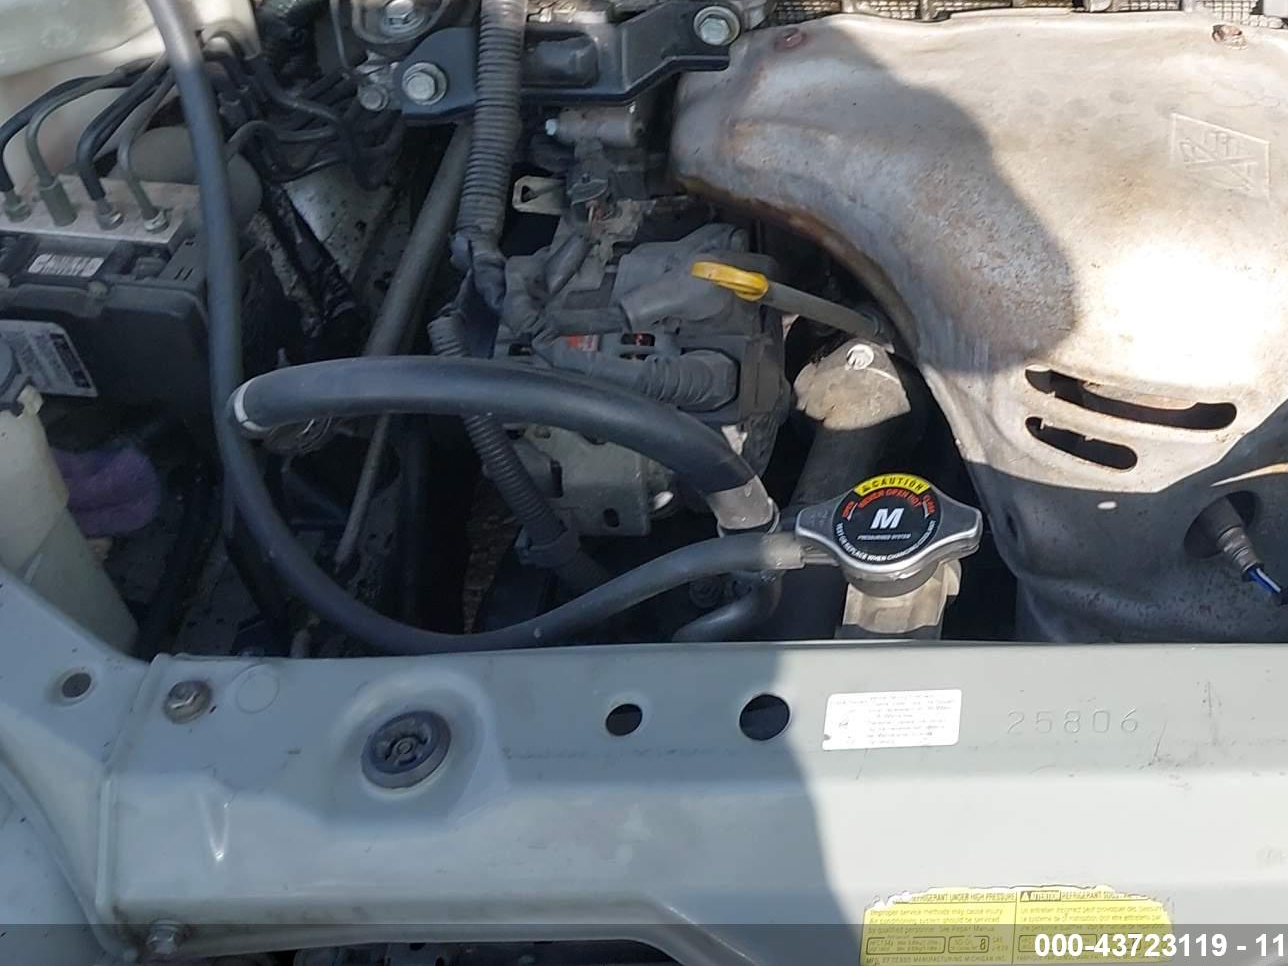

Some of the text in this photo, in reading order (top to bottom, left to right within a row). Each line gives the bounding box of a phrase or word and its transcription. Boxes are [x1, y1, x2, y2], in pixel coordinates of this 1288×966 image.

[871, 476, 924, 491] CAUTION
[870, 507, 905, 529] M
[843, 541, 868, 560] REPLACE
[867, 554, 887, 562] WHEN
[1007, 708, 1137, 733] 25806
[979, 938, 986, 951] 8
